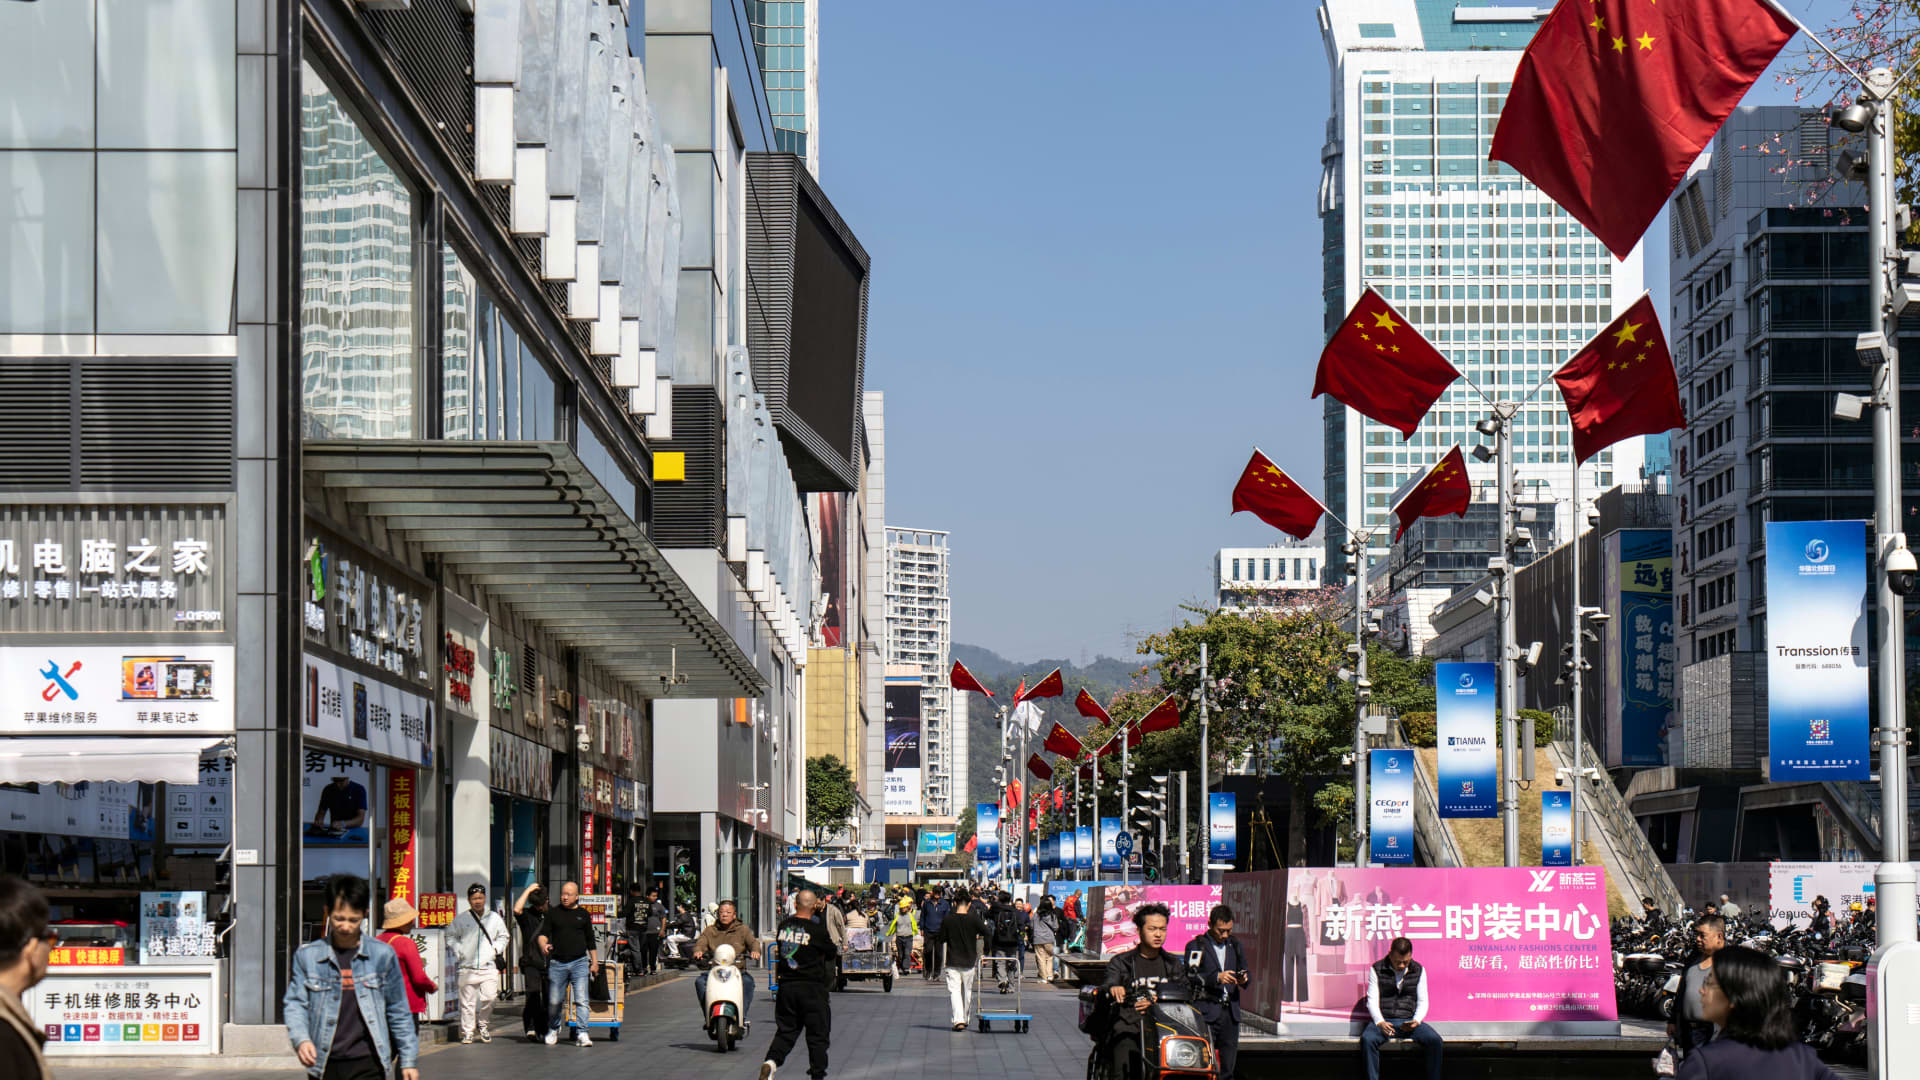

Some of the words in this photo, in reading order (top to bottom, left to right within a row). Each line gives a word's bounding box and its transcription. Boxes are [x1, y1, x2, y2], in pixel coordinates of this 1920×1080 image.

[1776, 644, 1838, 657] Transsion
[23, 712, 98, 724] 苹果维修服务
[136, 712, 199, 724] 苹果笔记本
[1455, 737, 1486, 745] TIANMA
[1375, 799, 1409, 808] CECport
[1559, 872, 1597, 886] 新燕兰
[420, 895, 460, 910] 高价回收
[1325, 902, 1601, 941] 新燕兰时装中心
[1468, 944, 1516, 952] XINYANLAN
[1519, 944, 1562, 952] FASHIONS
[1563, 944, 1598, 952] CENTER
[76, 949, 120, 965] 快速换屏
[44, 992, 201, 1009] 手机维修服务中心
